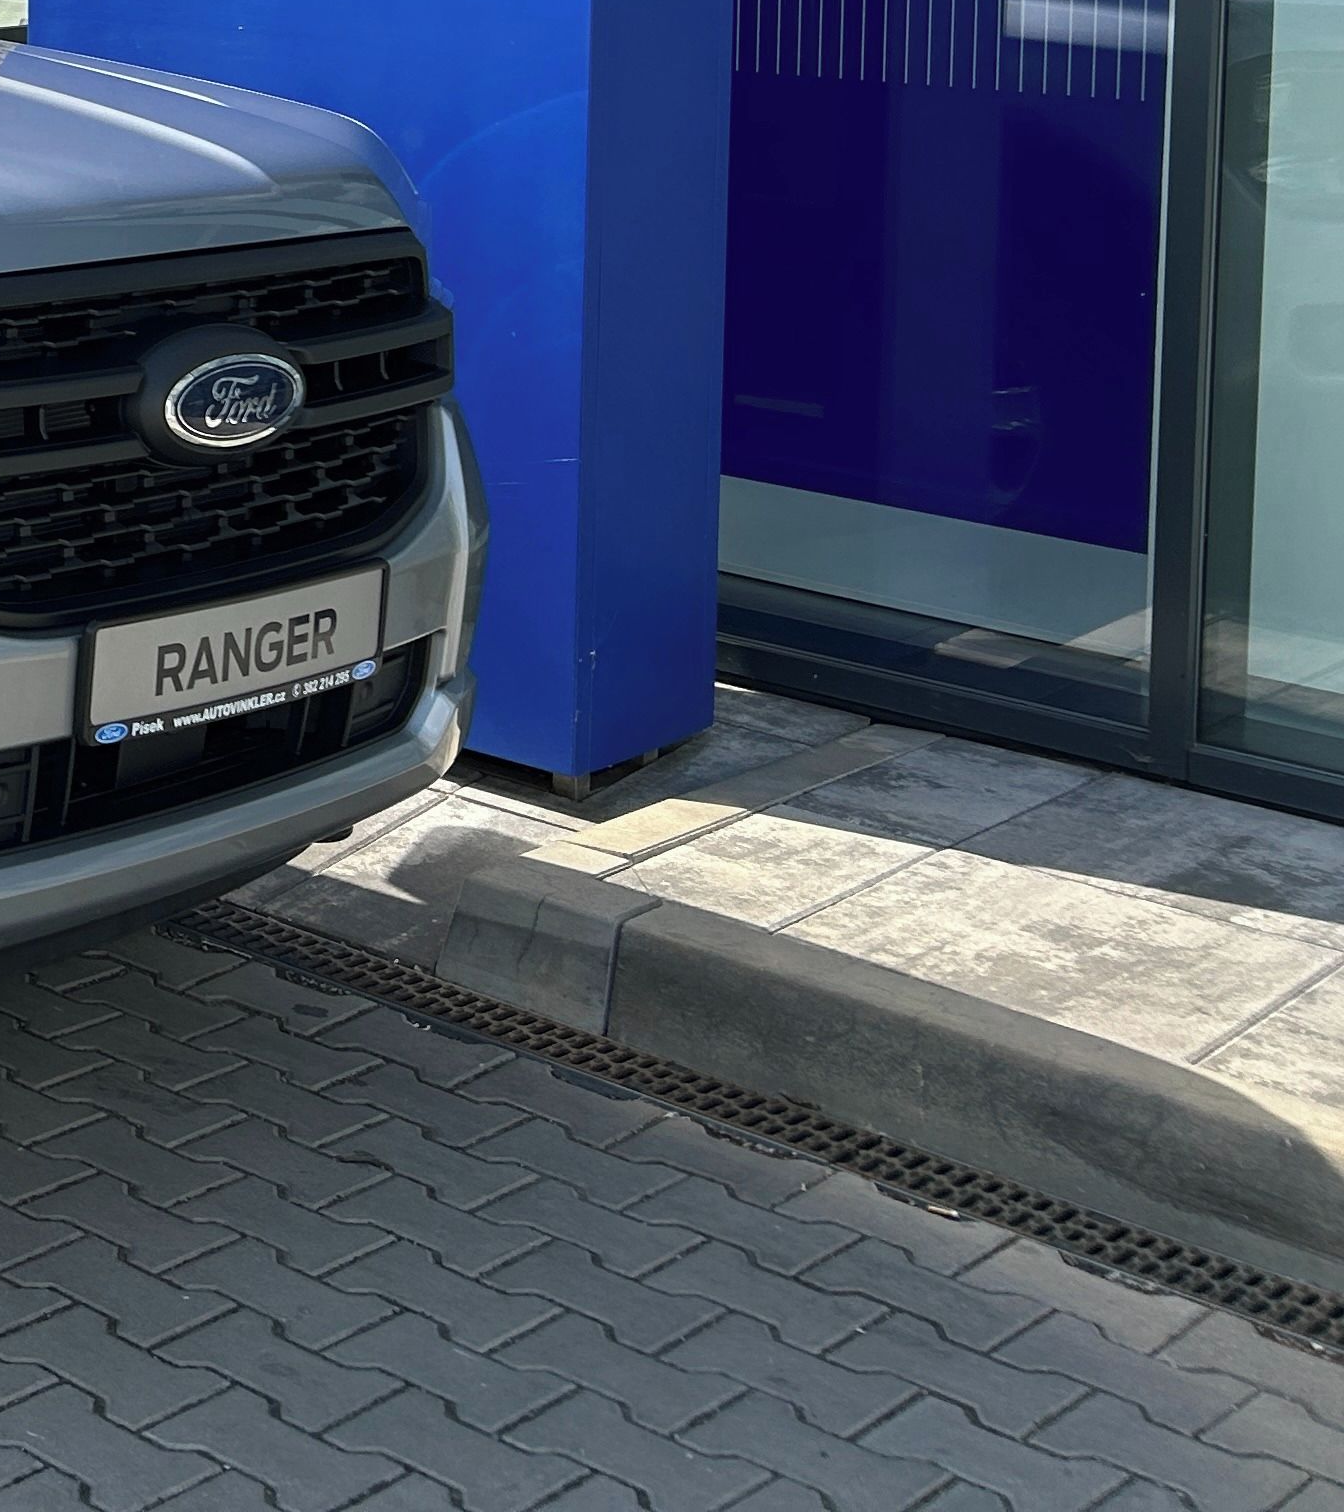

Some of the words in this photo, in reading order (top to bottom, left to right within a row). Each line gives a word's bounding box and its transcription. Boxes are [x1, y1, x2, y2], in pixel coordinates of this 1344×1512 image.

[204, 374, 278, 428] Ford
[154, 607, 338, 697] RANGER
[172, 691, 287, 728] www.AUTOVINKLER.cz
